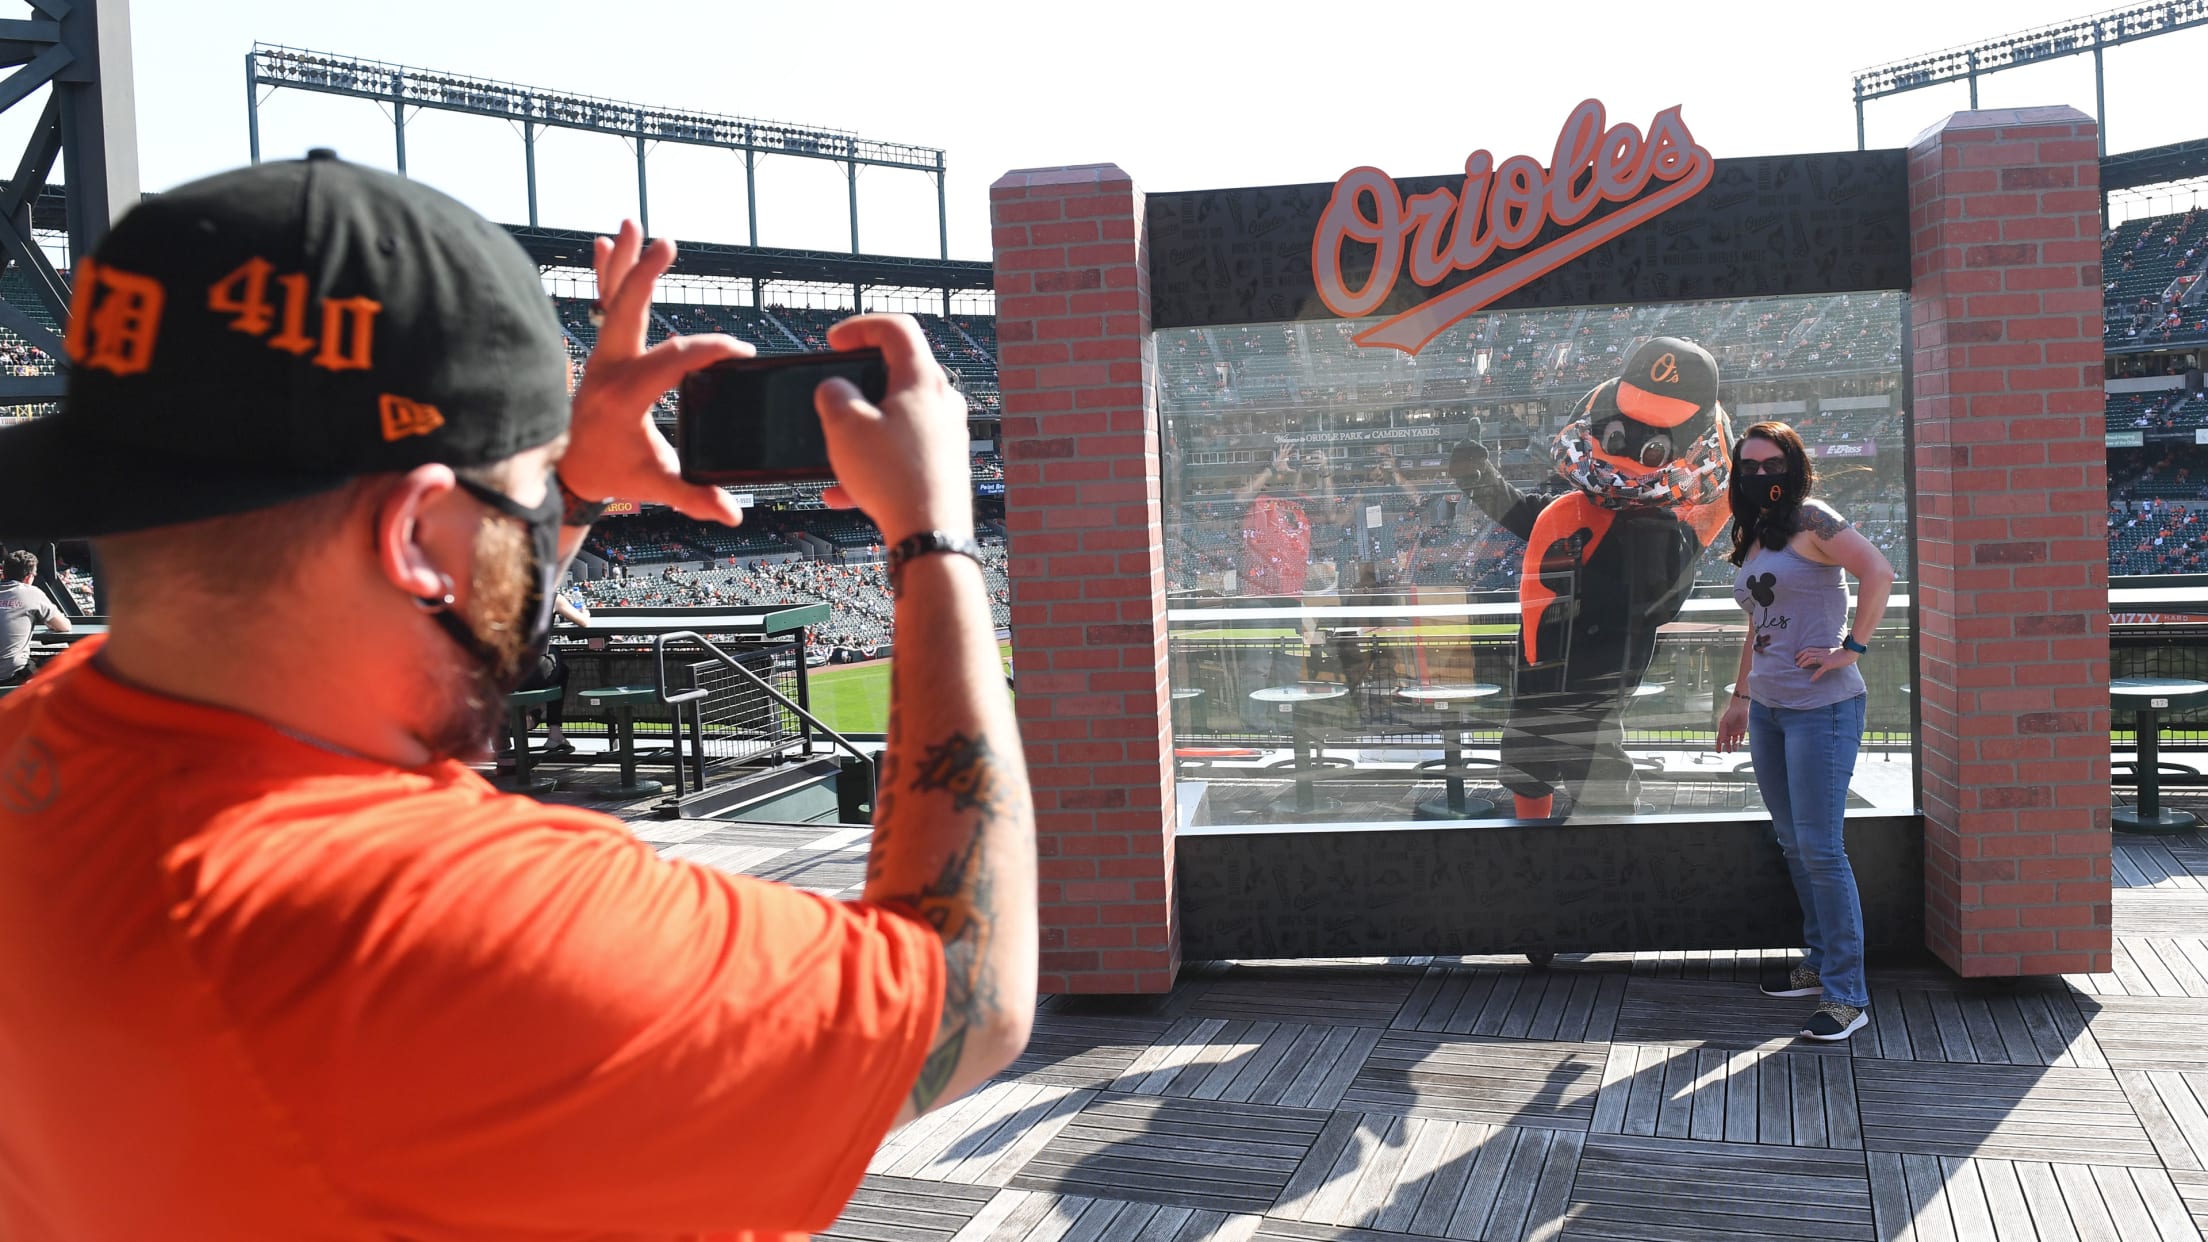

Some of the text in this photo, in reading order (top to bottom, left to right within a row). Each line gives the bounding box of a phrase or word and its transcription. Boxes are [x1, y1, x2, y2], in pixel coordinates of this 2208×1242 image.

[1312, 98, 1712, 318] Orioles
[208, 256, 382, 371] 410
[1650, 352, 1680, 383] O's
[1305, 433, 1339, 442] ORIOLE
[1340, 432, 1363, 440] PARK
[1372, 430, 1410, 439] CAMDEN
[1411, 428, 1440, 436] YARDS
